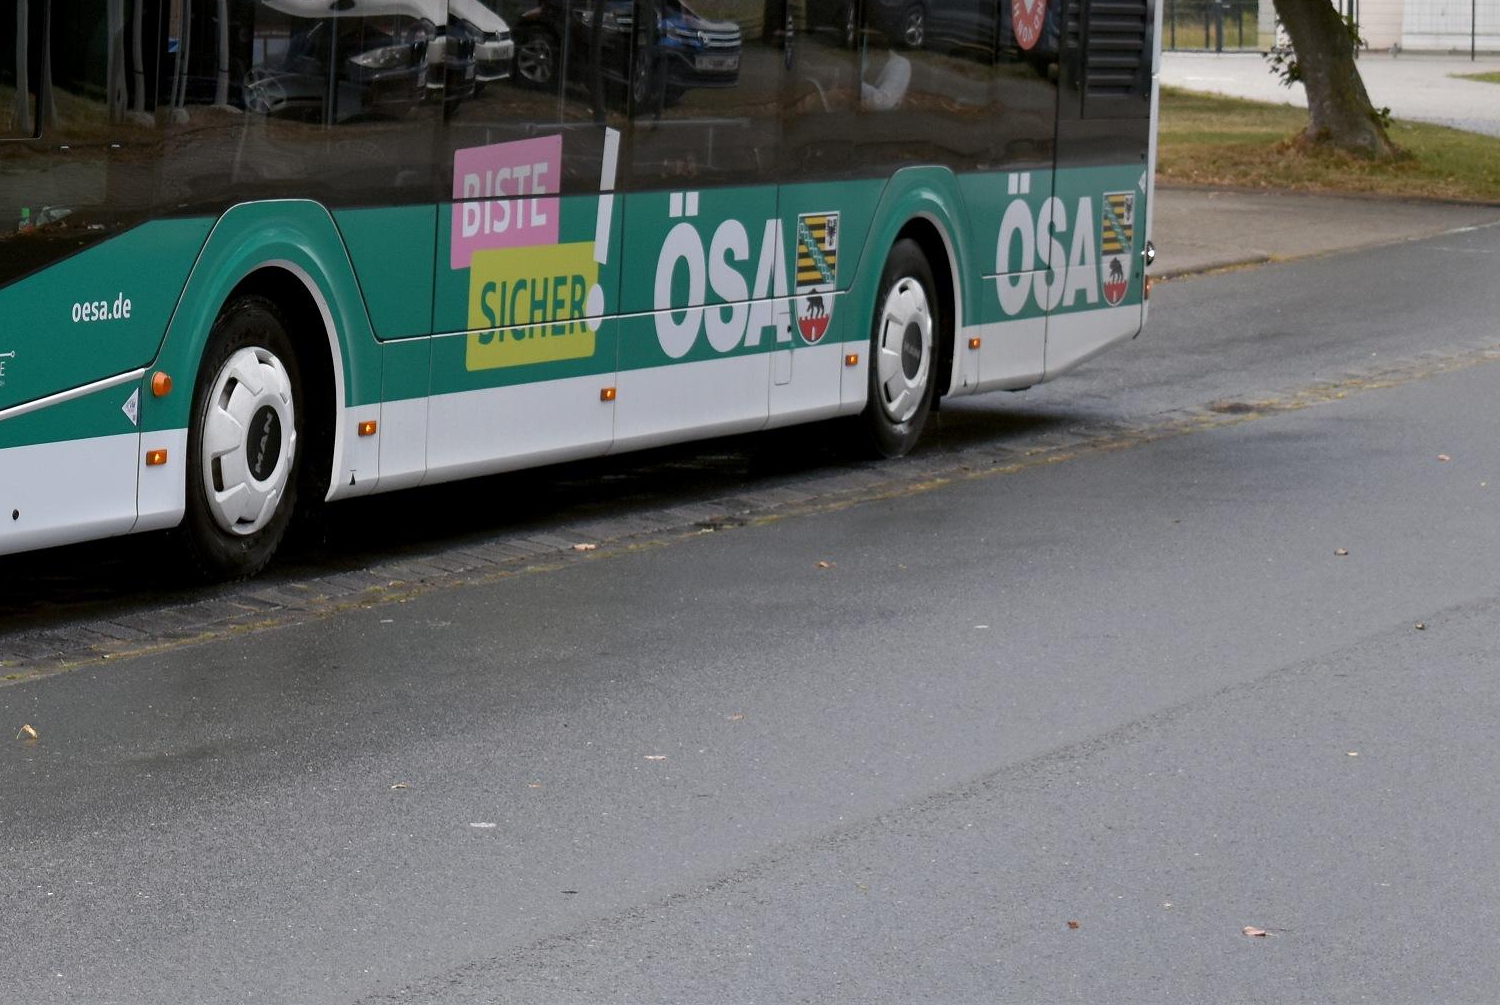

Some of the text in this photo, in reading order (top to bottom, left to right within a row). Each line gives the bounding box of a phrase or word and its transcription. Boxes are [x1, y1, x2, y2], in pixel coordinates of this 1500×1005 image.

[462, 162, 549, 238] BISTE
[654, 191, 793, 359] ÖSA
[995, 172, 1098, 316] ÖSA
[72, 291, 131, 323] oesa.de
[254, 411, 273, 473] MAN
